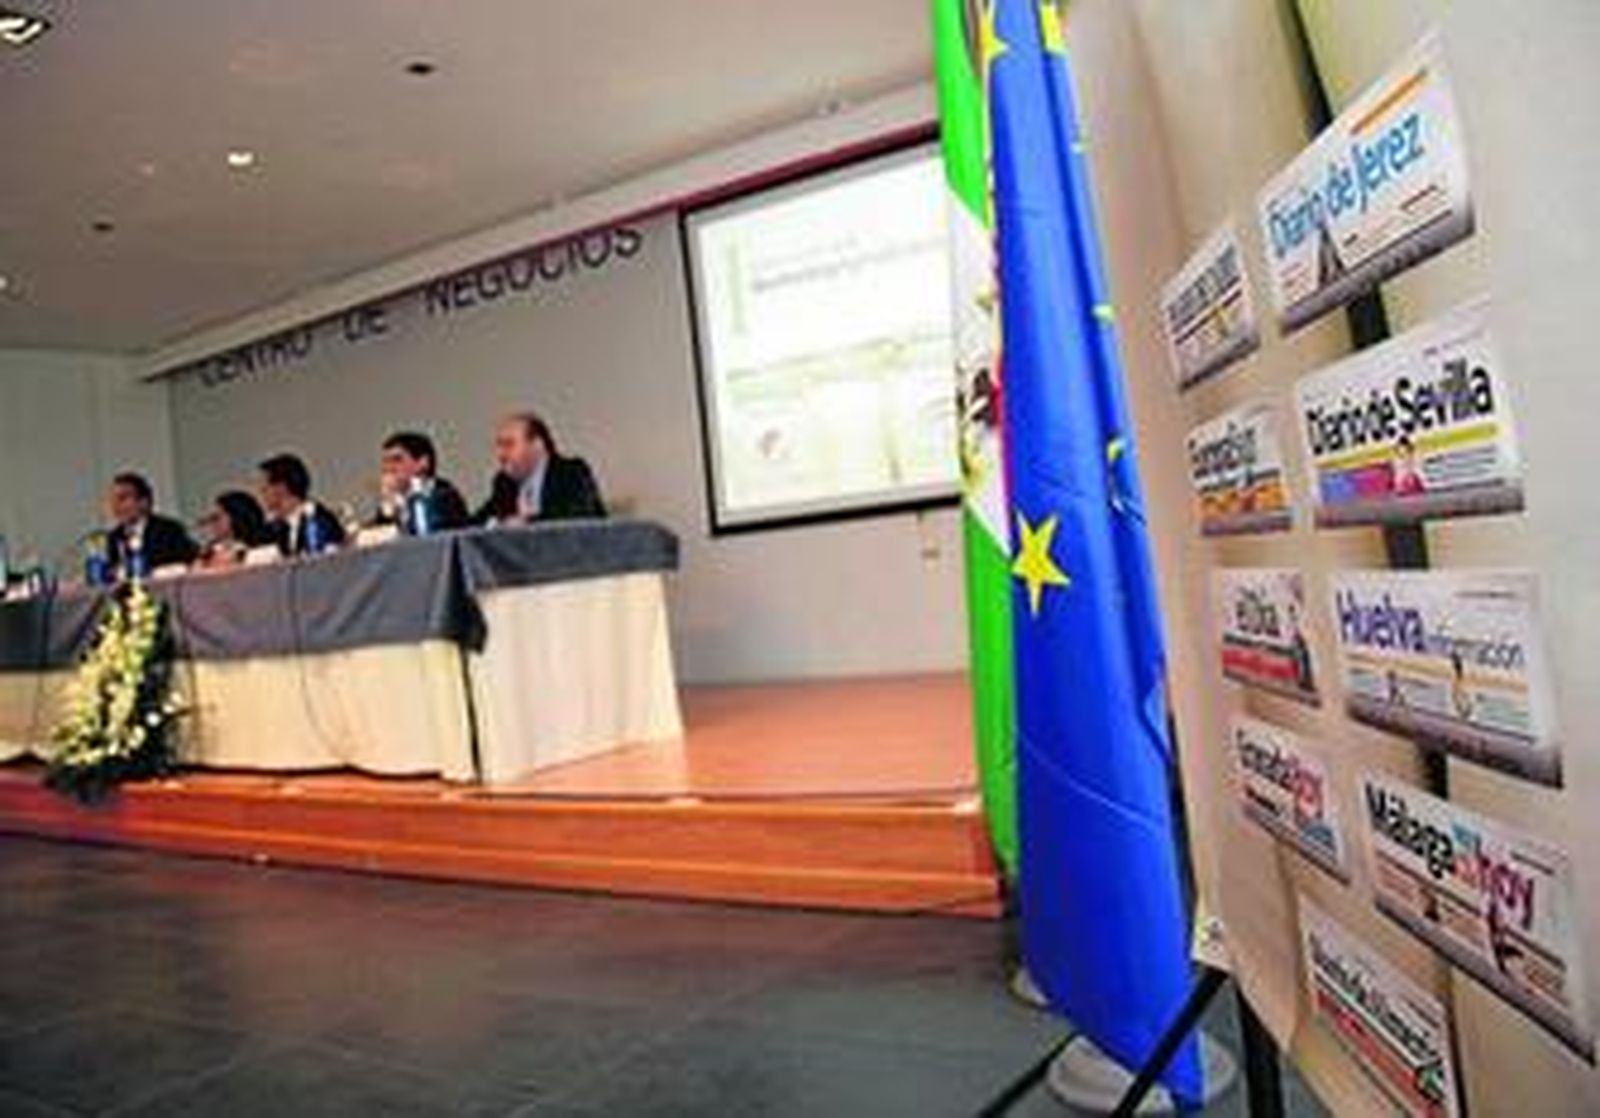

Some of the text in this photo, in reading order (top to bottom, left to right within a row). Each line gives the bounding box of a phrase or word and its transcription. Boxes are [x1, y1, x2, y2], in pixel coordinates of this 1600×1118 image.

[1351, 114, 1426, 213] Jerez
[424, 226, 643, 315] NEGOCIOS
[1306, 357, 1495, 456] Diario de Sevilla
[1335, 589, 1426, 652] Huelva
